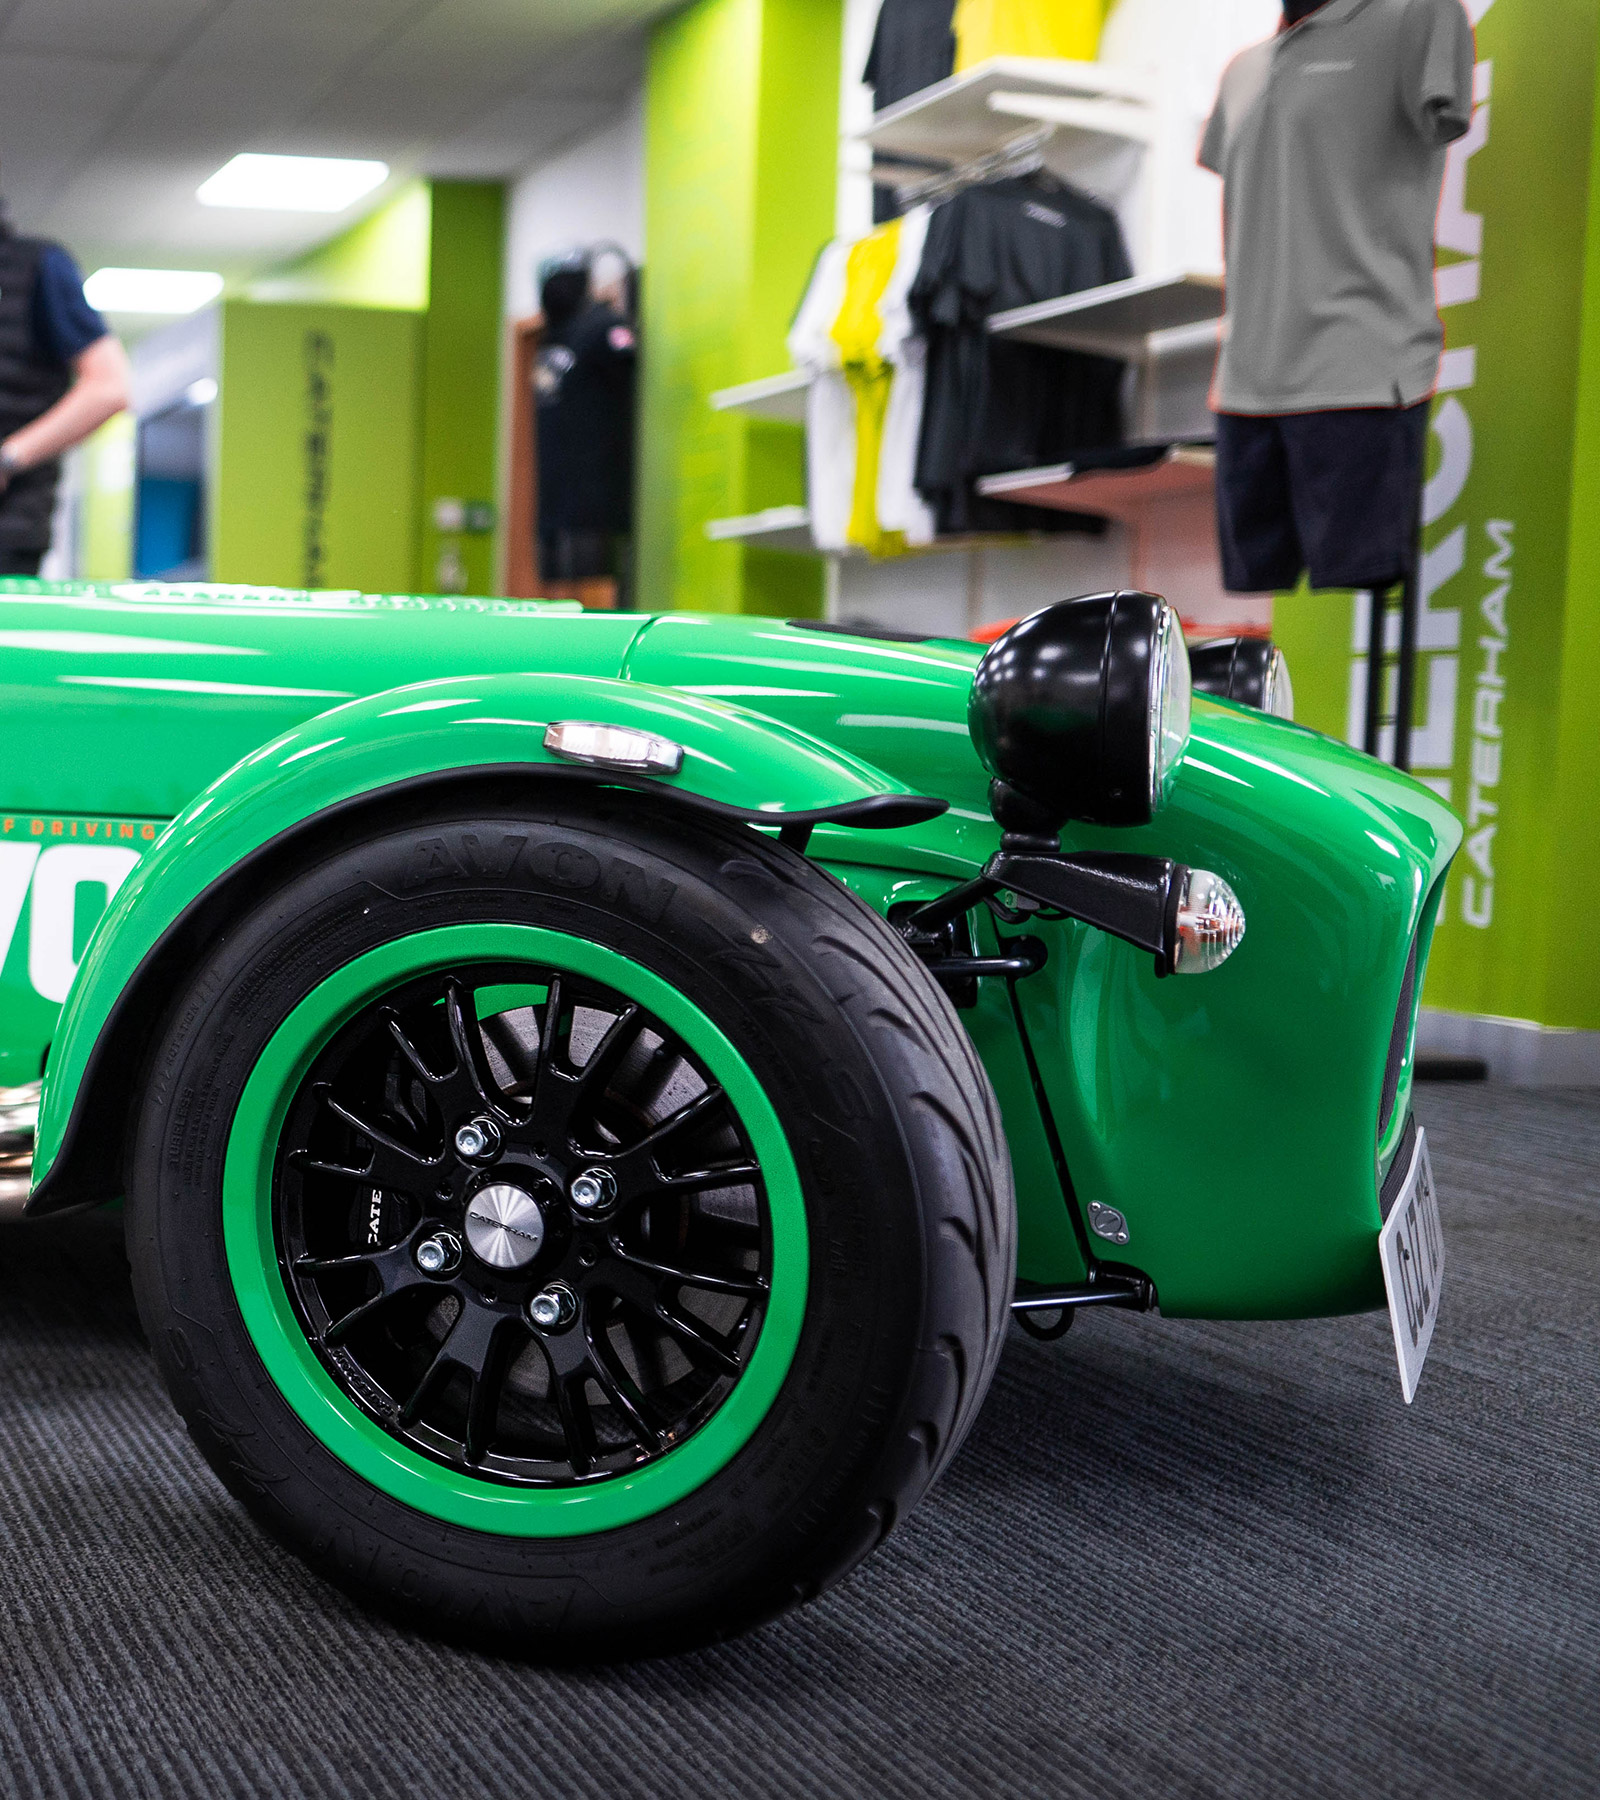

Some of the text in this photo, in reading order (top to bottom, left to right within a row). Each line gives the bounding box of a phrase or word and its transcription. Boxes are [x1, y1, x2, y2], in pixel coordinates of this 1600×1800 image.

[1461, 518, 1515, 928] CATERHAM
[30, 819, 156, 840] DRIVING
[403, 834, 678, 924] AVON
[469, 1211, 539, 1242] CATERHAM
